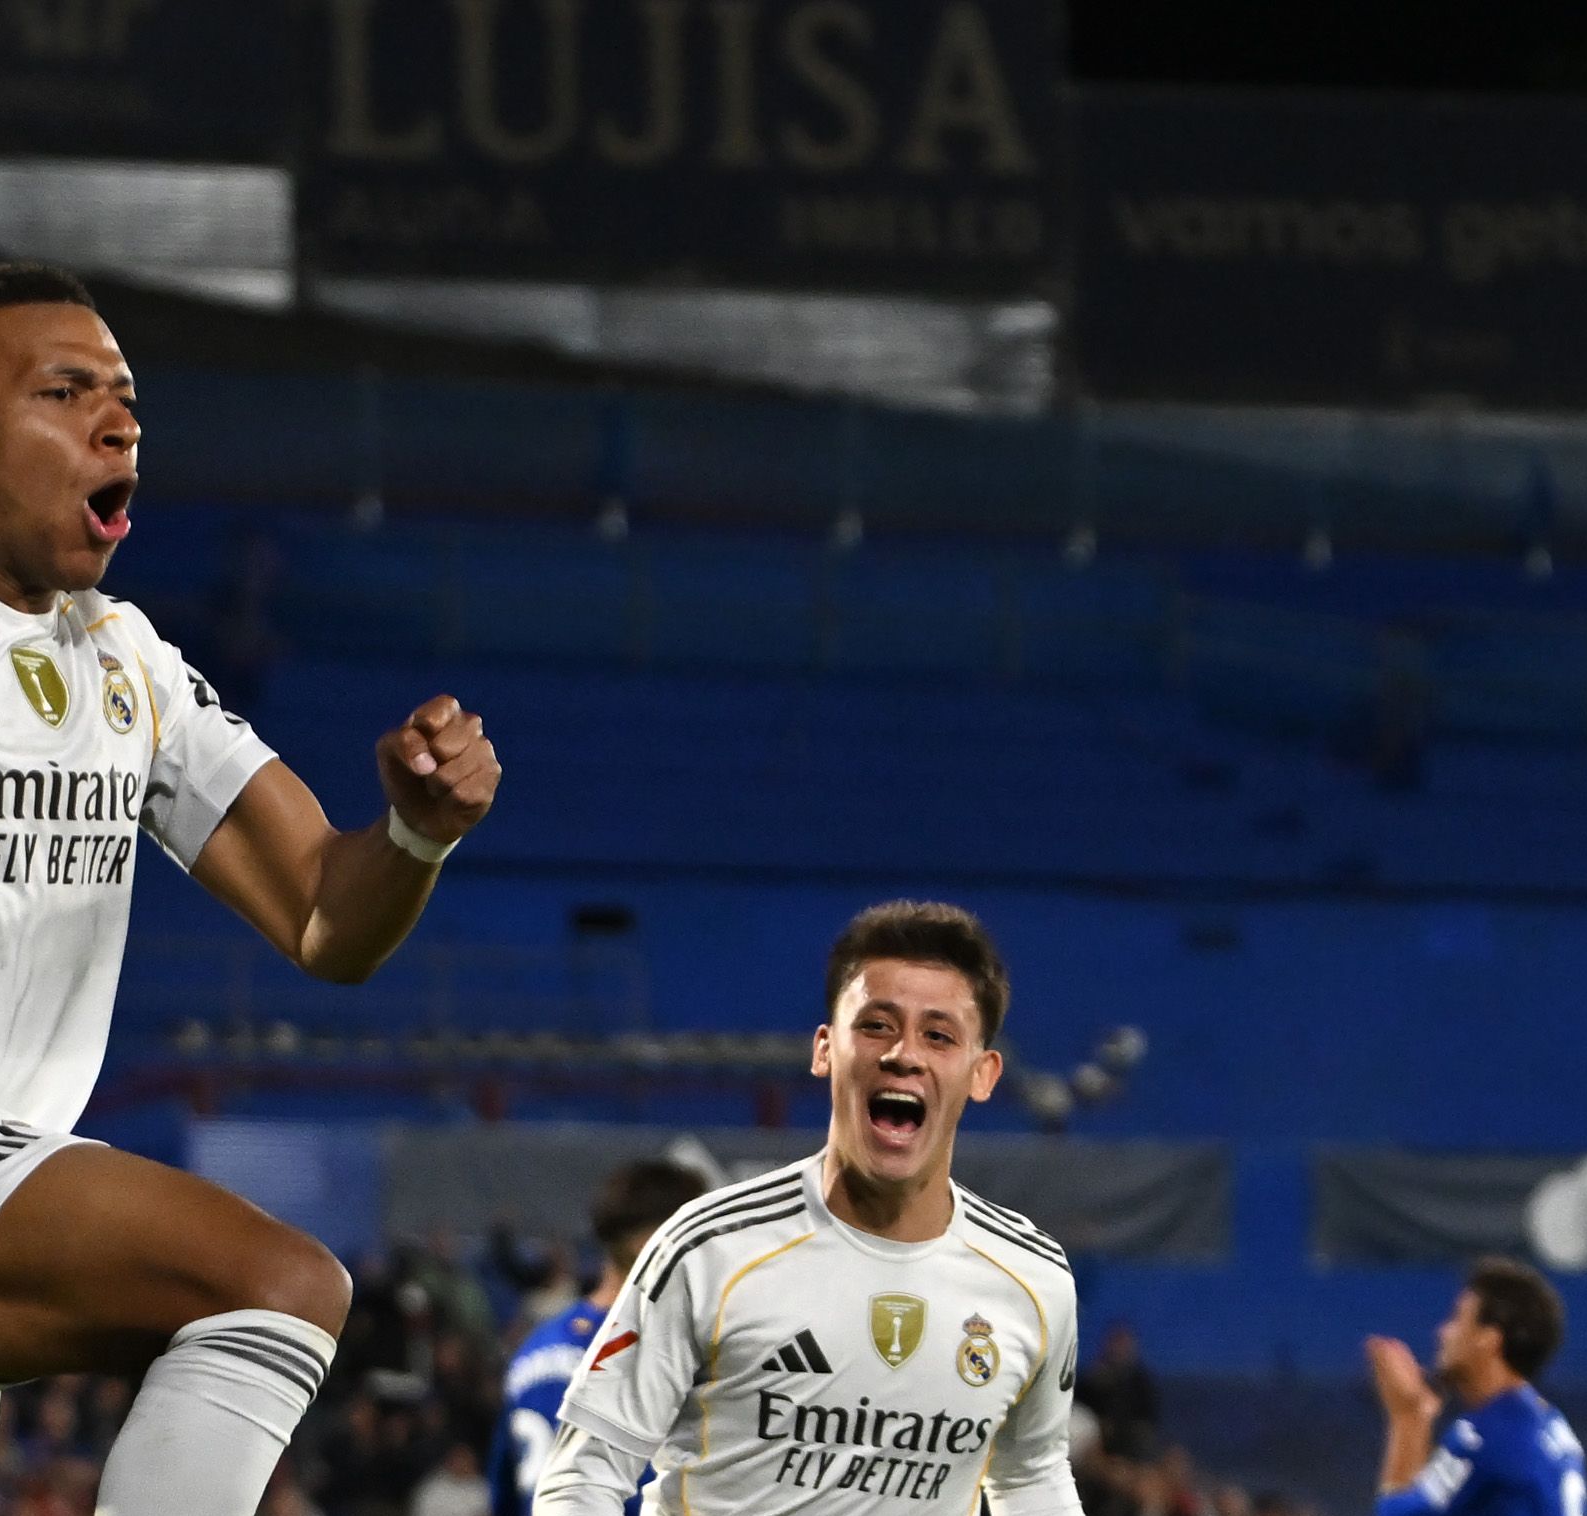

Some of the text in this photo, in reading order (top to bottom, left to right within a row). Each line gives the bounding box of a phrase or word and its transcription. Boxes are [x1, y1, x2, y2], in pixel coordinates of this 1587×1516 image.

[325, 0, 1038, 177] LUJISA
[47, 833, 132, 885] BETTER
[757, 1388, 993, 1454] Emirates
[775, 1446, 951, 1500] FLY BETTER
